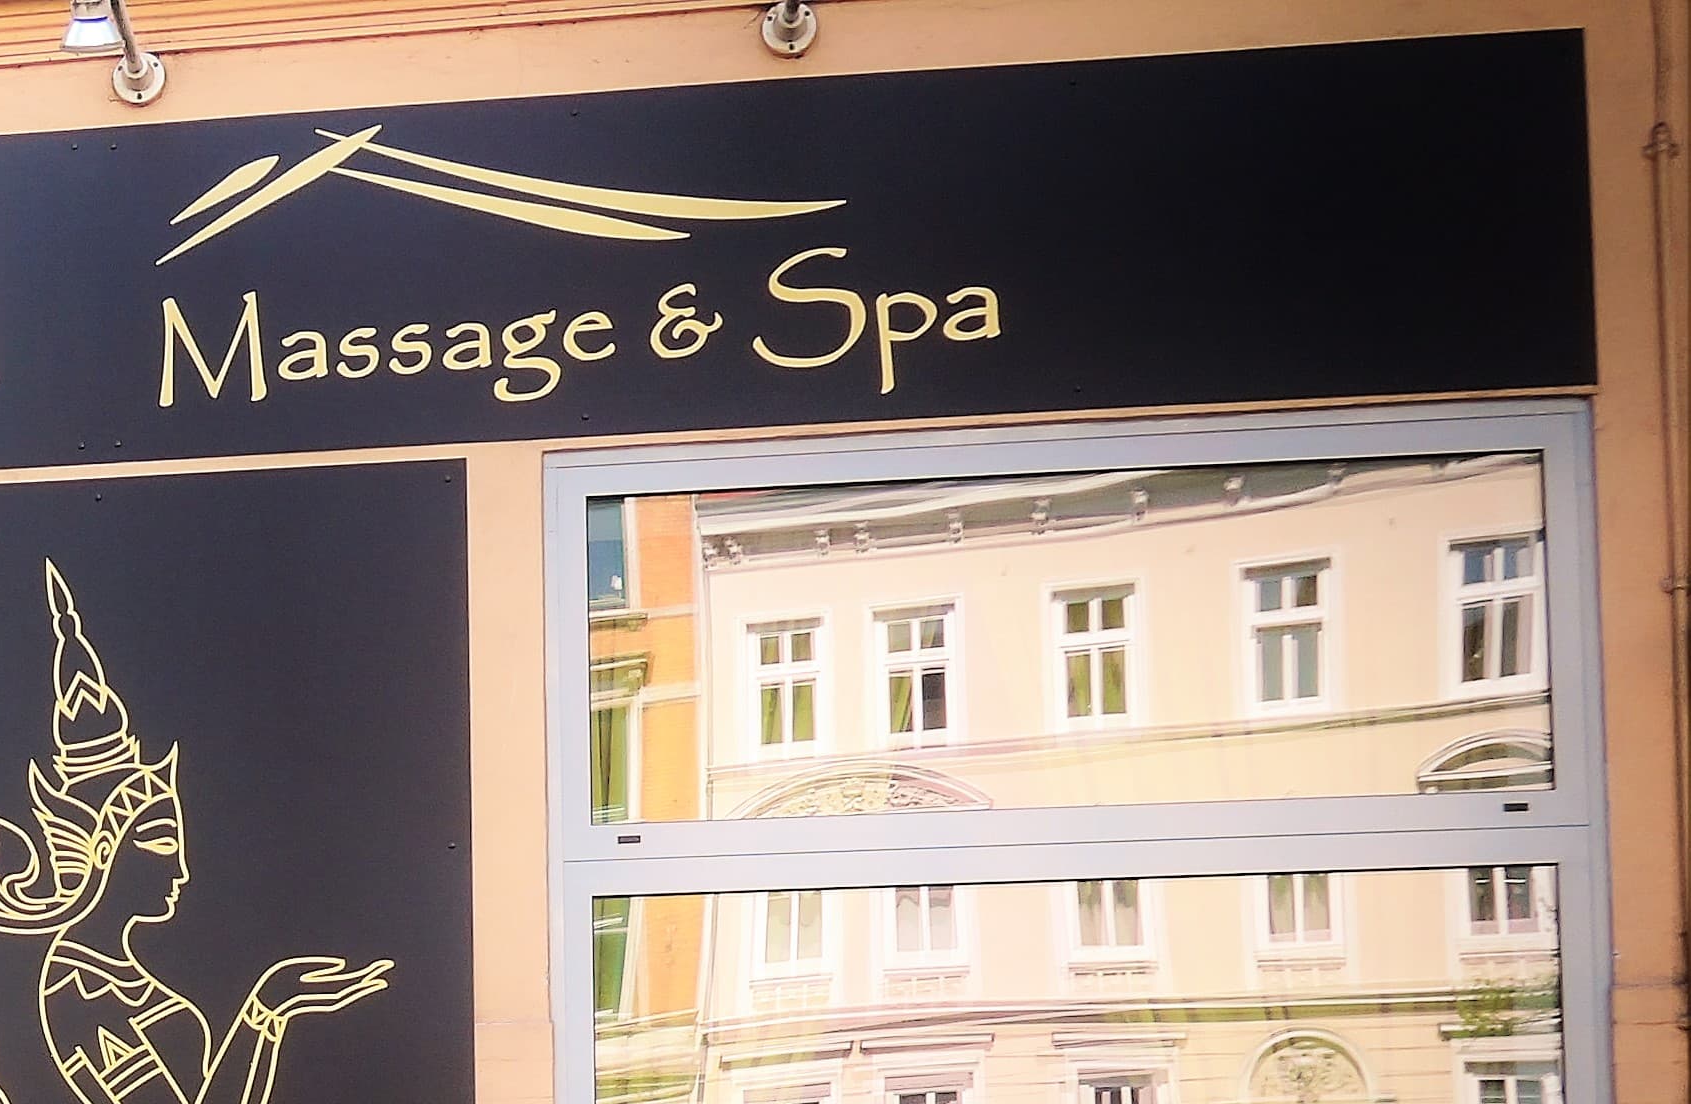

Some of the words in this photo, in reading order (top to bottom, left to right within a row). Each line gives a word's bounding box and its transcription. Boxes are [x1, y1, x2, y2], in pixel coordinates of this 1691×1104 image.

[157, 290, 616, 407] Massage
[650, 283, 723, 358] &
[752, 247, 1002, 394] Spa
